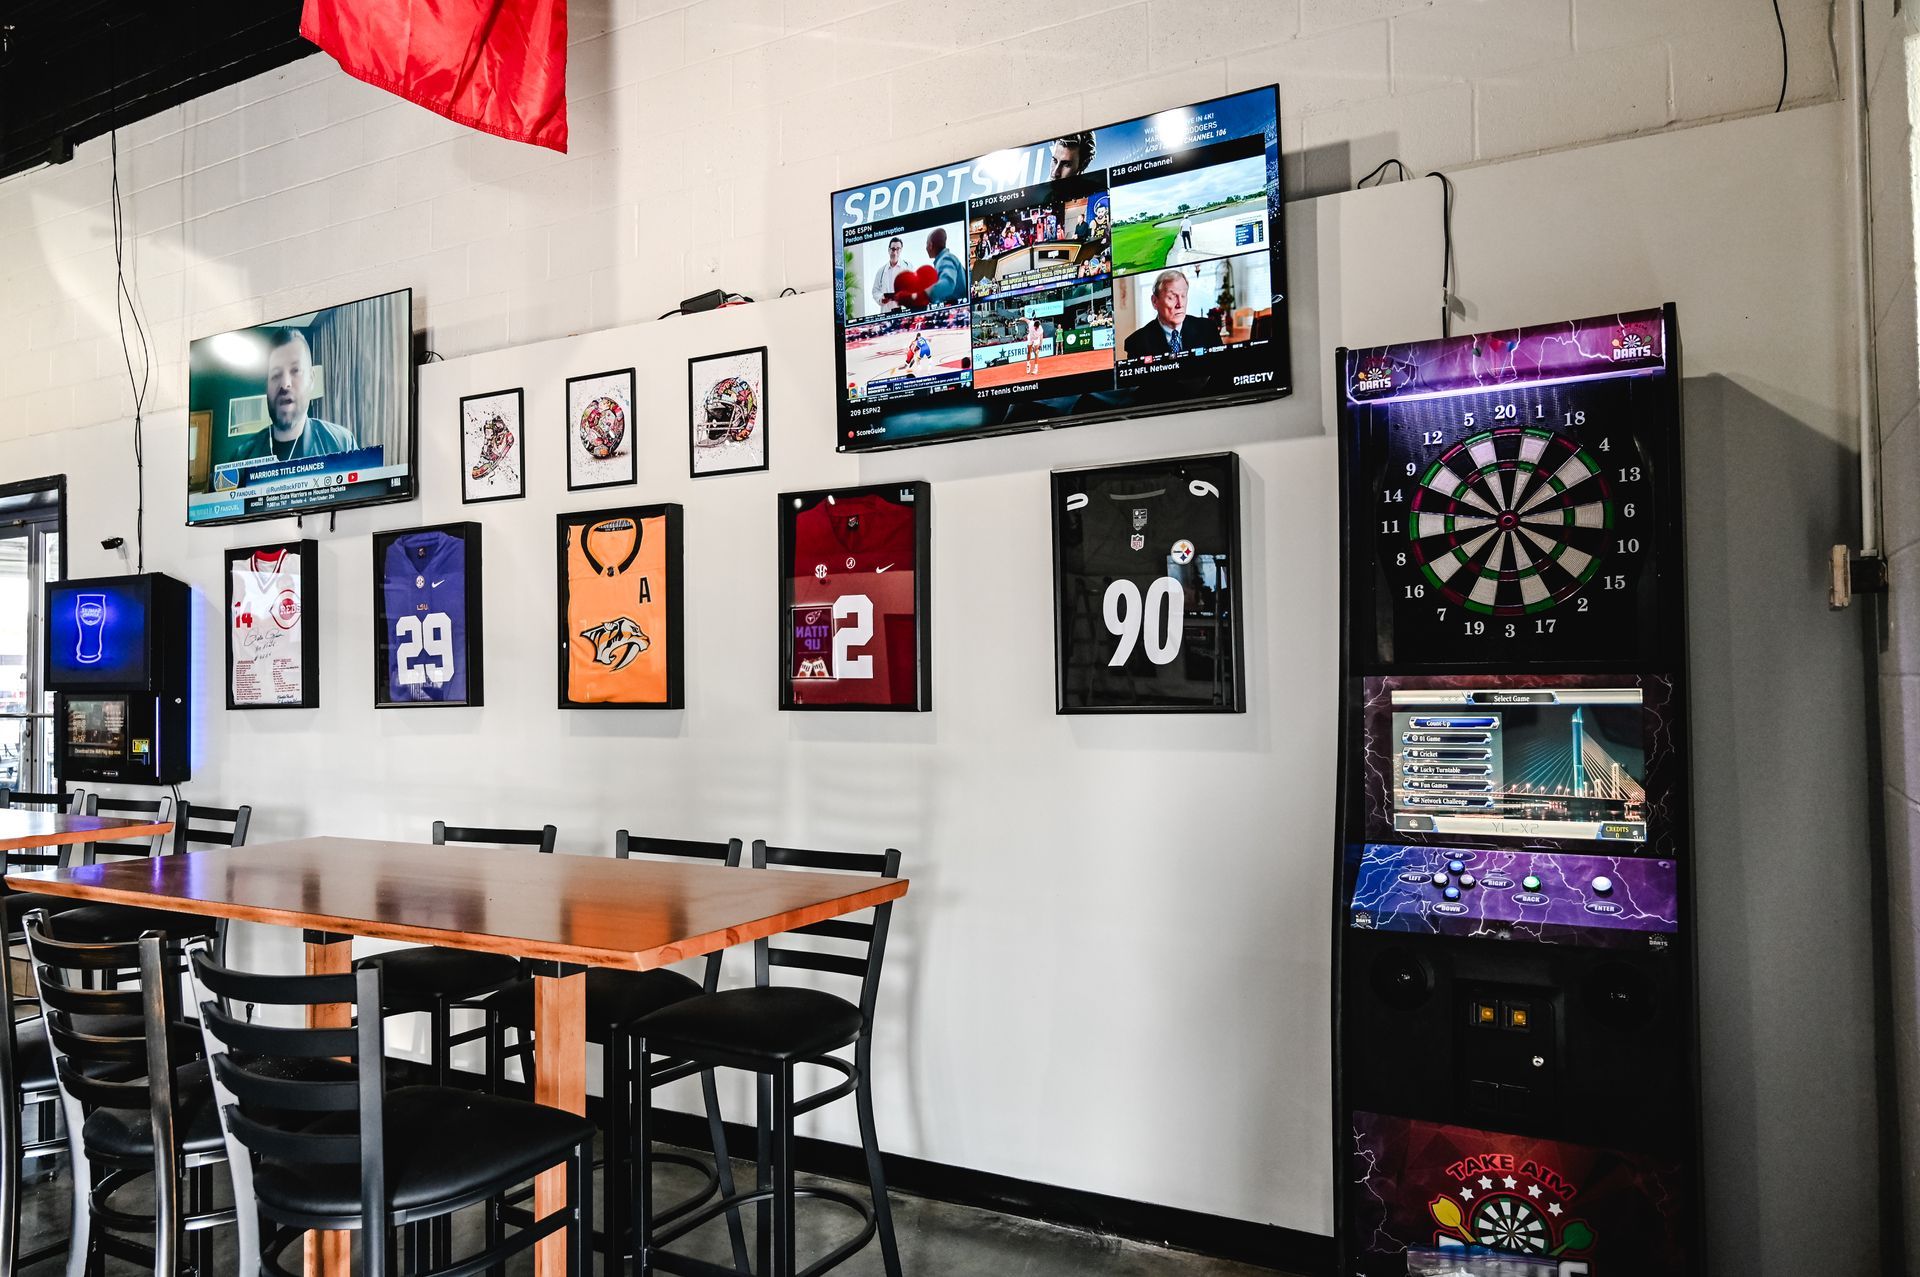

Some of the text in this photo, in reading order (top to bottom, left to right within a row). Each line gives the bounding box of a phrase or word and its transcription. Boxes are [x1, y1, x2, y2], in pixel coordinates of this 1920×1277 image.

[1204, 112, 1214, 120] 4K!
[1183, 131, 1214, 144] CHANNEL
[1216, 128, 1227, 137] 106
[1112, 157, 1173, 177] 218 Golf Channel
[971, 190, 1025, 209] 219 FOX Sports 1
[845, 225, 873, 237] 206 ESPN
[845, 235, 863, 244] Pardon
[873, 226, 905, 237] Interruption
[1613, 345, 1651, 360] DARTS
[1119, 362, 1180, 378] 212 NFL Network
[1233, 371, 1274, 386] DIRECTV
[1360, 378, 1391, 391] DARTS
[977, 382, 1039, 398] 217 Tennis Channel
[850, 406, 881, 417] 209 ESPN2
[1494, 404, 1516, 419] 20
[1535, 405, 1544, 418] 1
[1563, 411, 1586, 426] 18
[1463, 412, 1475, 426] 5
[856, 427, 886, 437] ScoreGuide
[1422, 431, 1443, 445] 12
[1599, 438, 1610, 451] 4
[250, 462, 325, 481] WARRIORS TITLE CHANCES
[1406, 462, 1417, 476] 9
[1618, 467, 1641, 482] 13
[236, 489, 257, 498] FANDUEL
[290, 491, 308, 499] Warriors
[1383, 489, 1403, 503] 14
[1624, 504, 1635, 518] 6
[1381, 520, 1400, 534] 11
[1617, 539, 1639, 554] 10
[1396, 553, 1406, 566] 8
[814, 563, 828, 579] SEC
[1603, 575, 1626, 590] 15
[639, 577, 651, 604] A
[1404, 585, 1424, 598] 16
[416, 603, 429, 611] LSU
[1577, 597, 1589, 612] 2
[235, 612, 253, 629] 14
[1103, 576, 1185, 667] 90
[1436, 608, 1447, 622] 7
[1464, 621, 1485, 635] 19
[1504, 623, 1516, 638] 3
[1535, 619, 1557, 634] 17
[833, 594, 874, 679] 2
[396, 612, 455, 685] 29
[1493, 695, 1530, 703] Select Game
[1420, 767, 1435, 775] Lucky
[1442, 798, 1468, 807] Challenge
[1605, 825, 1629, 833] CREDITS
[1446, 1153, 1577, 1200] TAKE AIM
